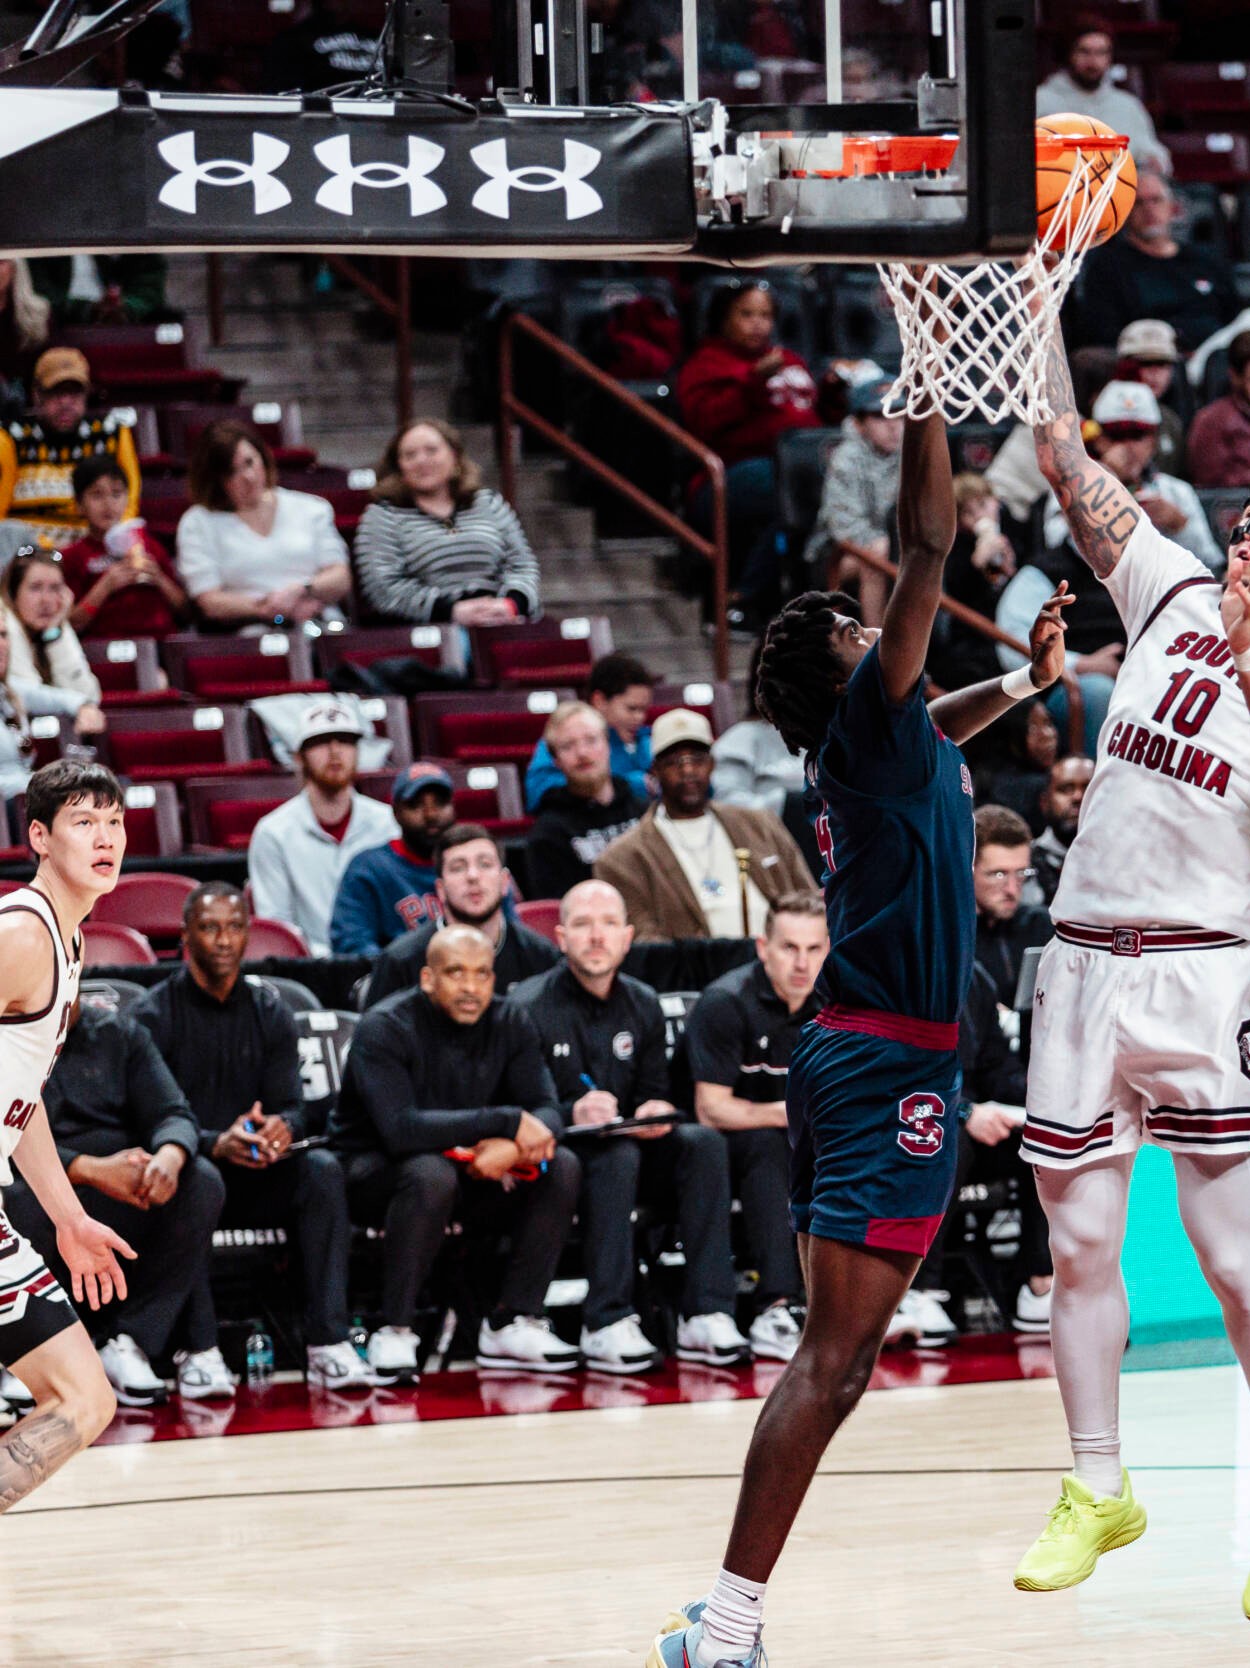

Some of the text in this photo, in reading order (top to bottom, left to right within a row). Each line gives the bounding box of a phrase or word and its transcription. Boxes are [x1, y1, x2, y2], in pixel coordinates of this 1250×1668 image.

[1165, 631, 1244, 691] SOU
[1152, 668, 1221, 738] 10
[1107, 721, 1233, 798] CAROLINA
